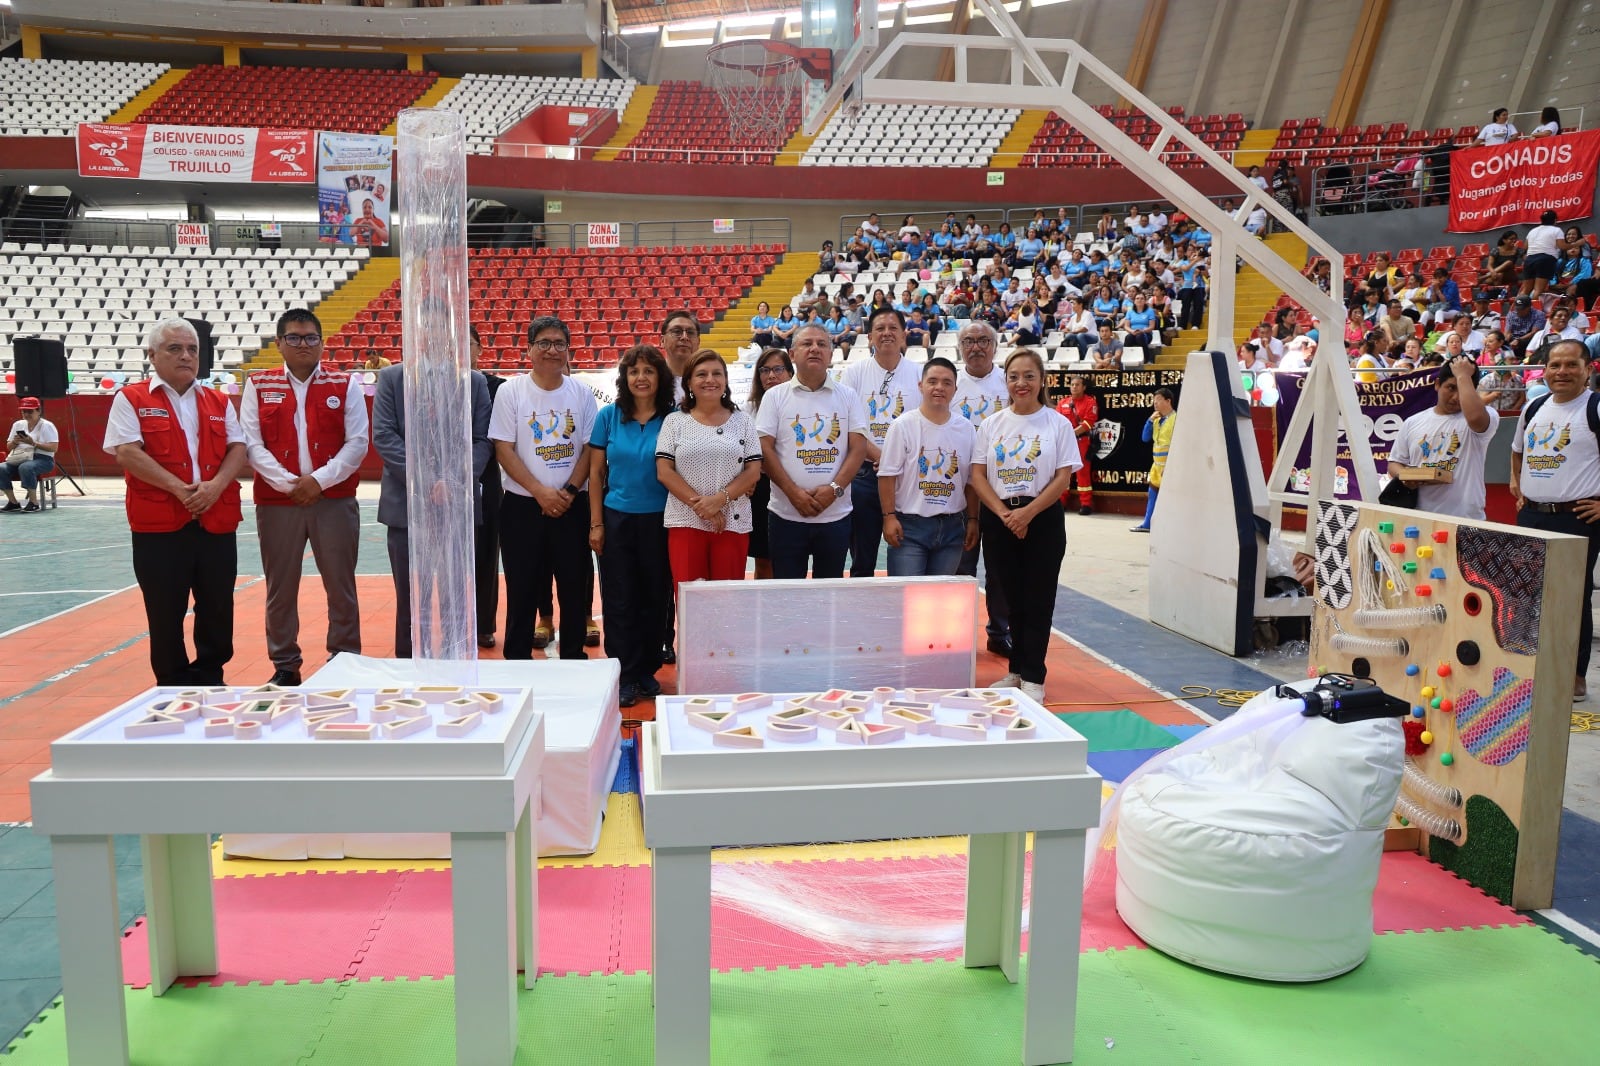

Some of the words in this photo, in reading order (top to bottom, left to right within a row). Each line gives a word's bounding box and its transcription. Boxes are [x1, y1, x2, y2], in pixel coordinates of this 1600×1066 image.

[153, 132, 245, 145] BIENVENIDOS
[100, 148, 117, 156] IPD
[194, 149, 216, 157] GRAN
[219, 149, 245, 158] CHIMÚ
[280, 154, 295, 162] IPD
[169, 160, 231, 173] TRUJILLO
[1470, 144, 1572, 179] CONADIS
[1458, 182, 1507, 200] Jugamos
[1539, 176, 1548, 188] y
[1549, 171, 1583, 185] todas
[1459, 210, 1481, 221] por
[1482, 207, 1497, 218] un
[1524, 195, 1581, 210] inclusivo
[178, 224, 201, 235] ZONA
[589, 224, 611, 235] ZONA
[612, 224, 618, 235] J
[178, 235, 208, 245] ORIENTE
[589, 235, 618, 245] ORIENTE
[1047, 373, 1061, 388] DE
[1362, 374, 1435, 394] REGIONAL
[1103, 393, 1154, 409] TESORO
[536, 443, 567, 456] Historias
[543, 449, 575, 461] Orgullo
[797, 448, 830, 459] Historias
[830, 446, 839, 455] de
[803, 454, 836, 466] Orgullo
[1555, 454, 1567, 463] de
[1528, 460, 1561, 471] Orgullo
[998, 466, 1027, 479] Historias
[1003, 473, 1034, 485] Orgullo
[923, 487, 952, 497] Orgullo
